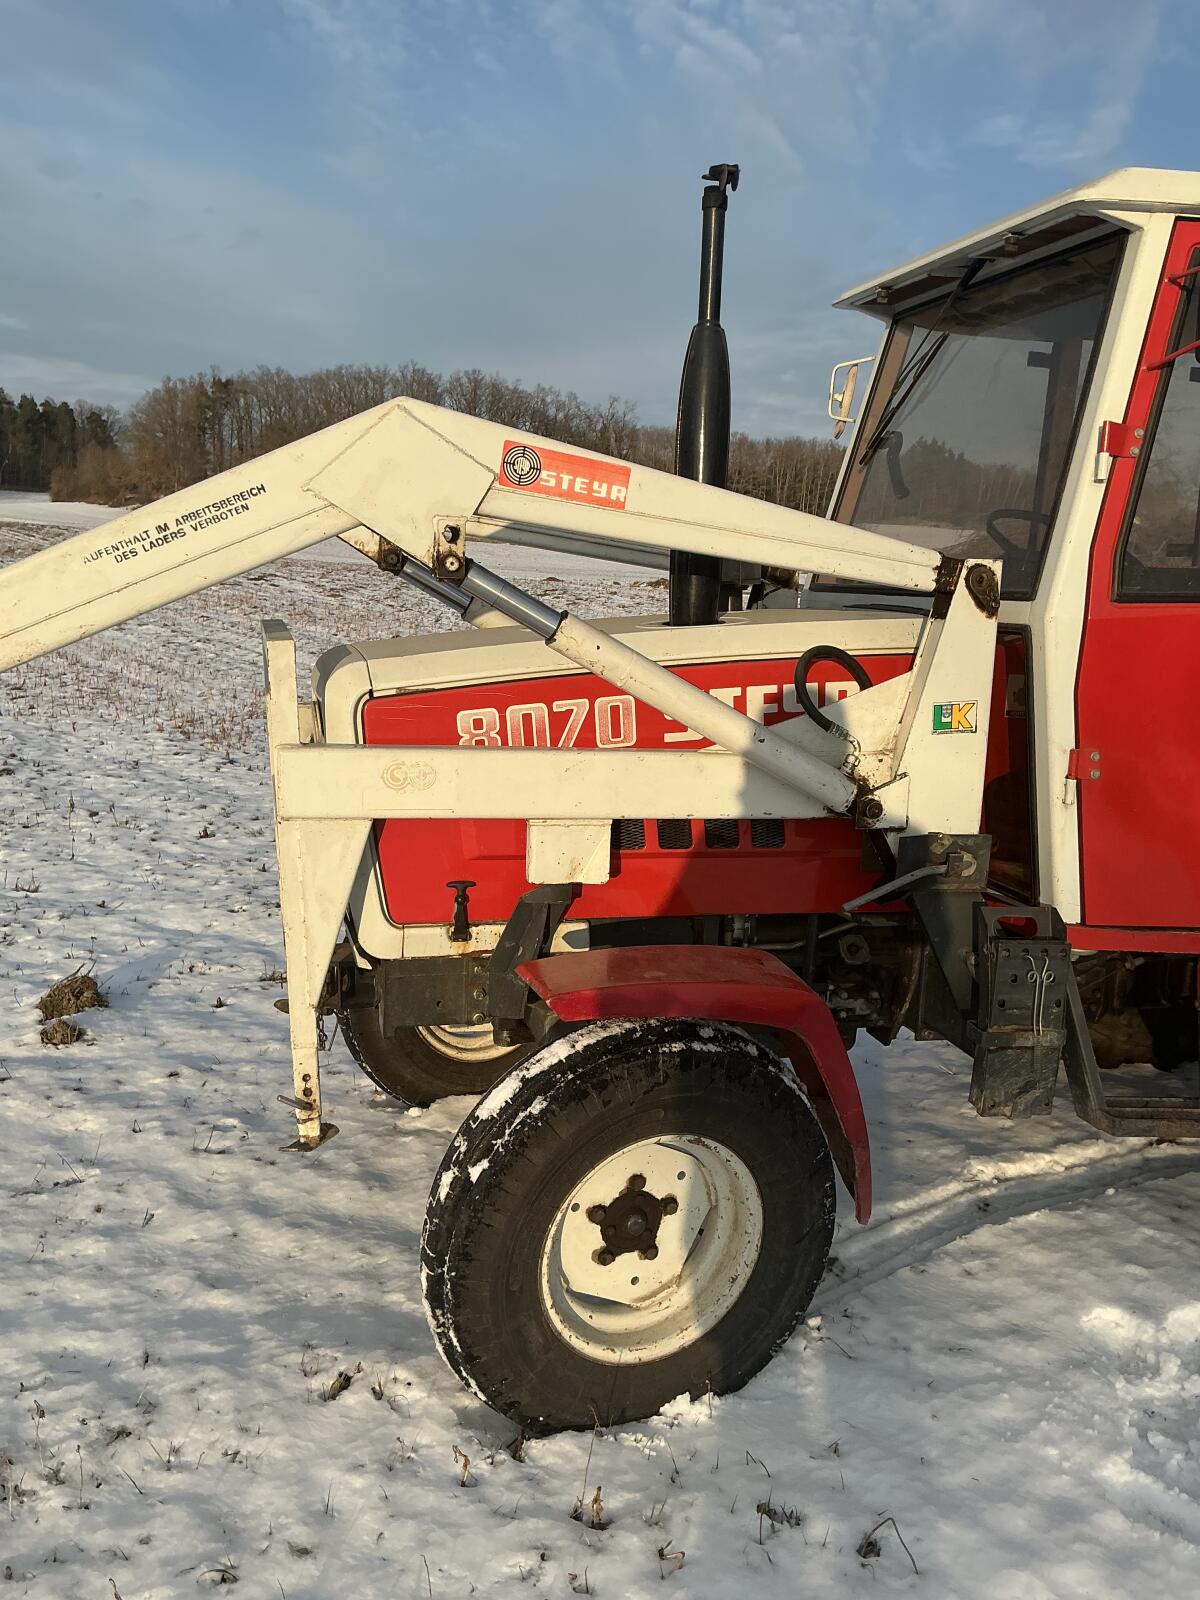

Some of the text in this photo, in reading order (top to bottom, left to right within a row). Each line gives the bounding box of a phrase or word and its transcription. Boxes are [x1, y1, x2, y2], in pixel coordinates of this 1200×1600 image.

[540, 470, 627, 502] STEYR
[82, 483, 267, 565] AUFENTHALT IM ARBEITSBEREICH
[114, 502, 250, 564] DES LADERS VERBOTEN
[457, 694, 637, 749] 8070
[933, 702, 976, 730] LK
